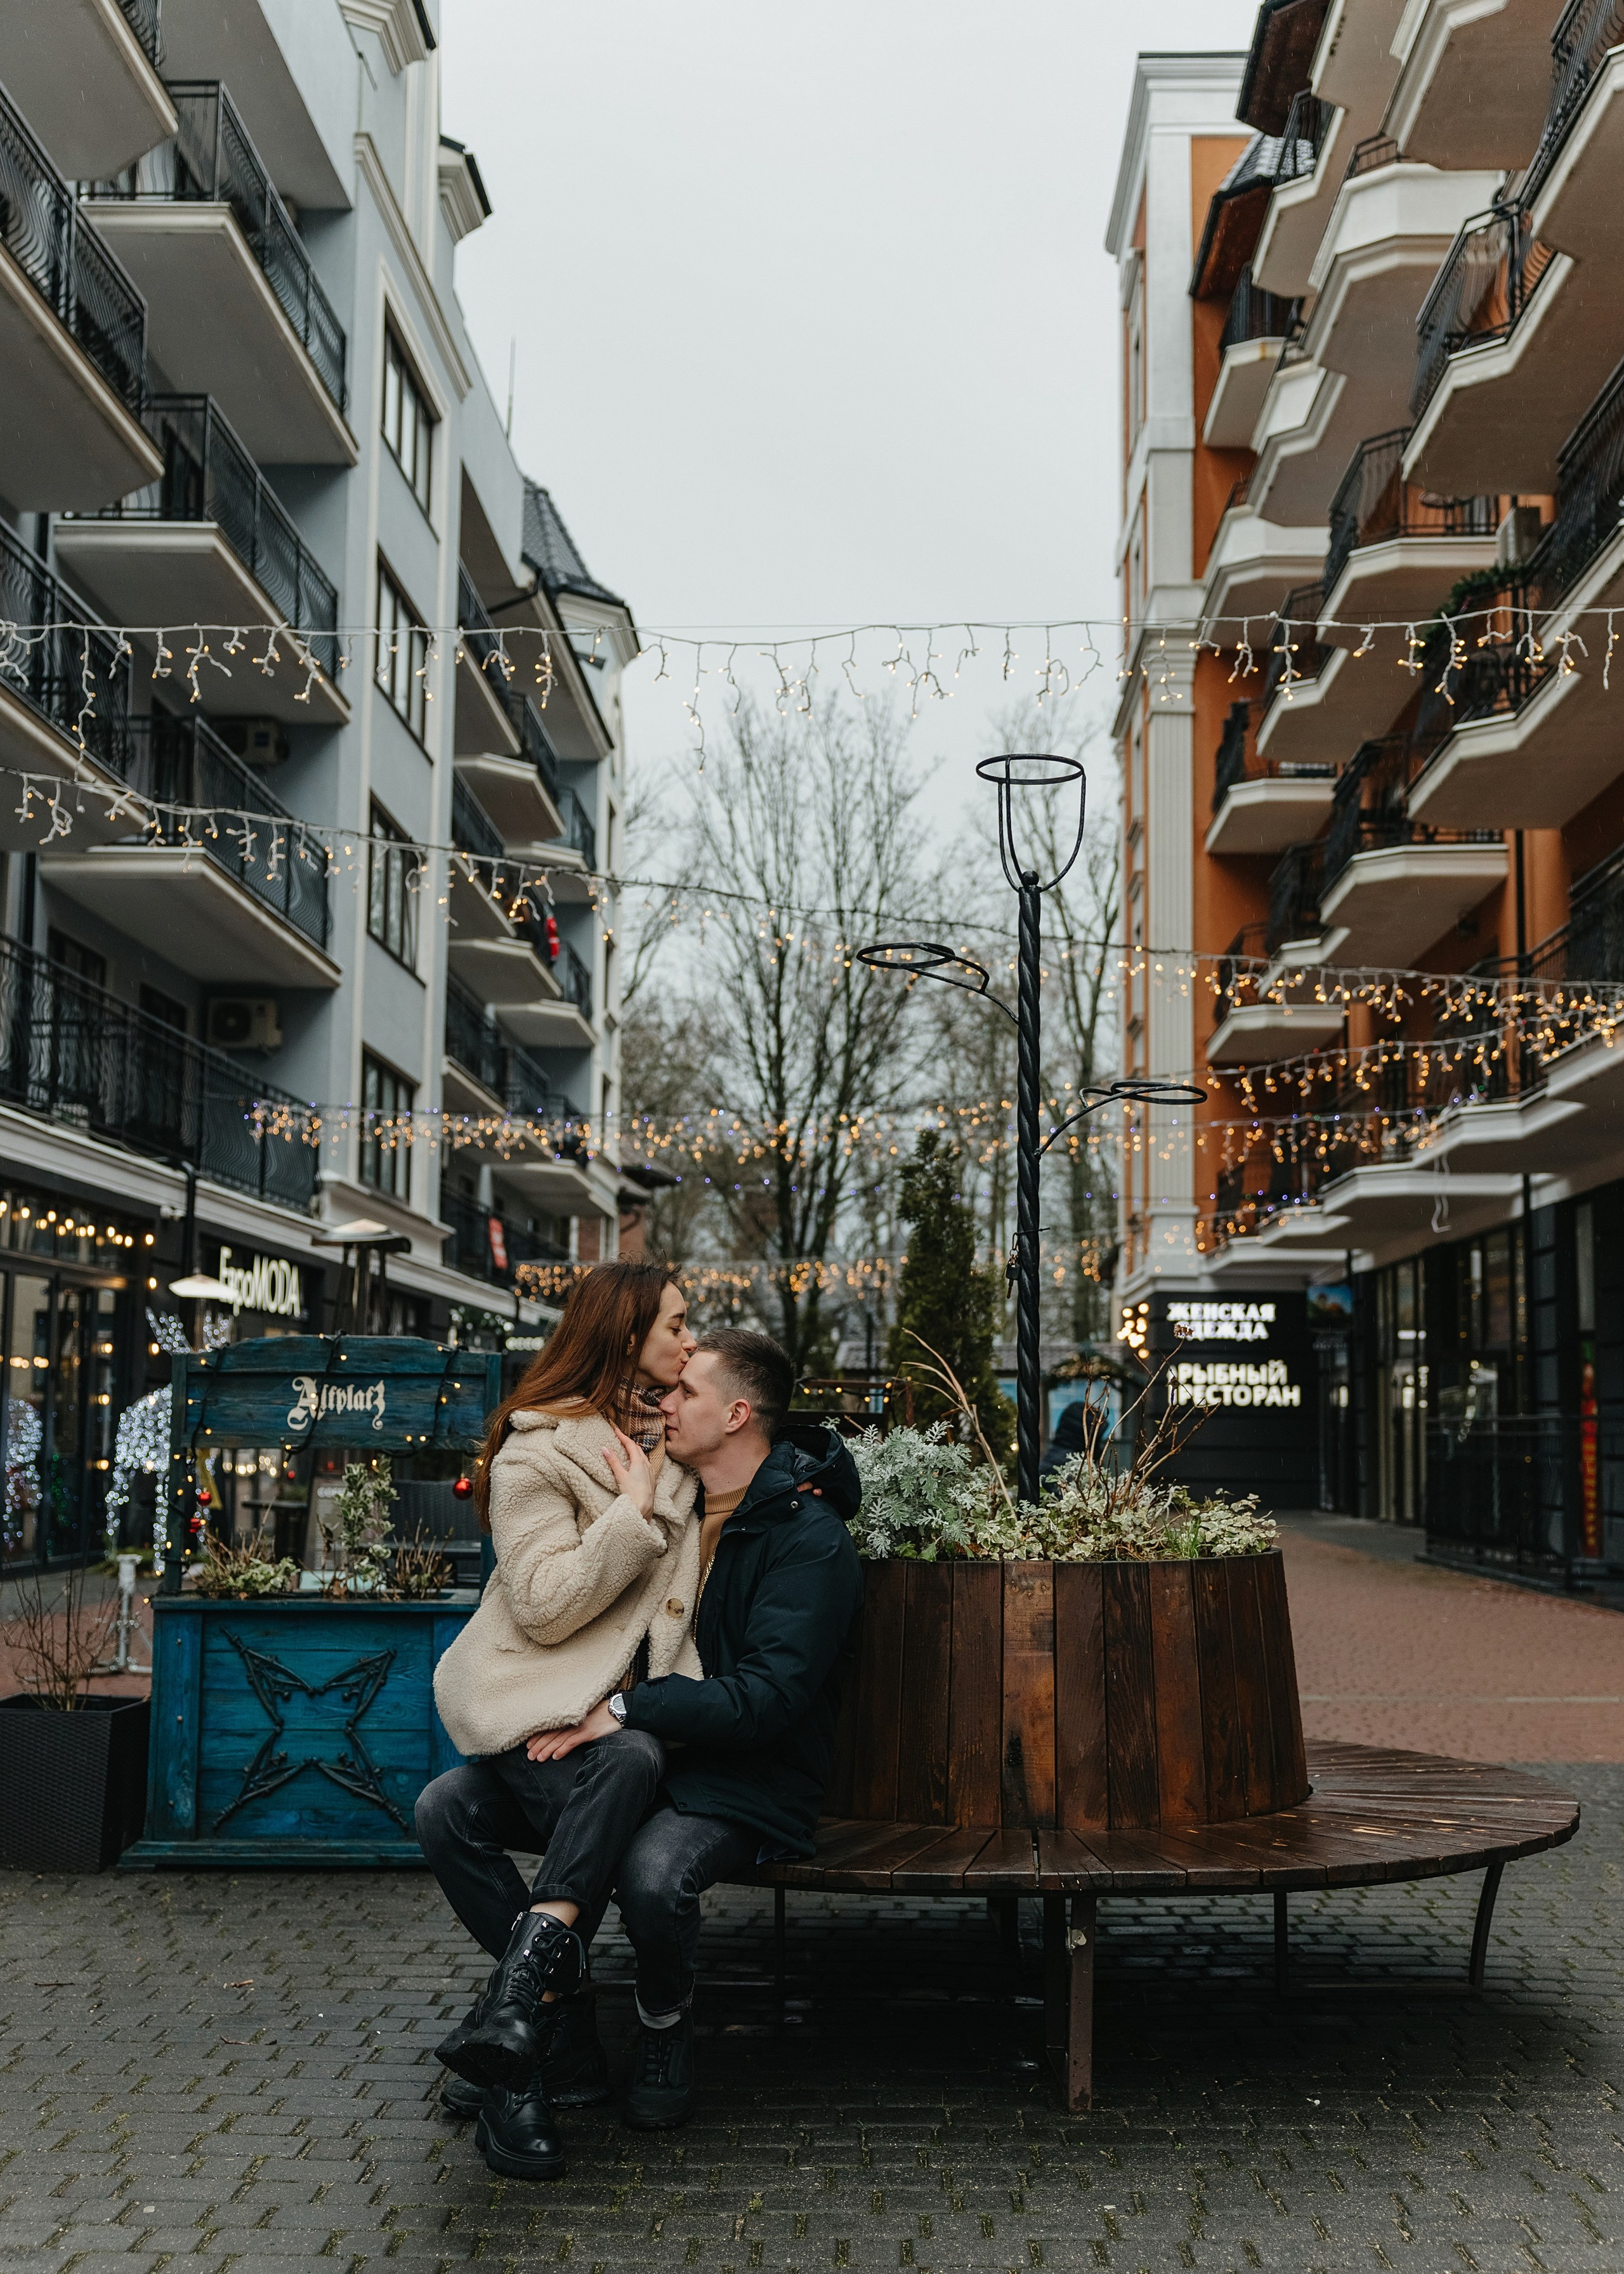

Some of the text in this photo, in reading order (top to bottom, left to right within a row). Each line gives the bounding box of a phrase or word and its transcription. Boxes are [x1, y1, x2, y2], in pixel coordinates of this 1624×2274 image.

[1167, 1303, 1276, 1322] ЖЕНСКАЯ
[1178, 1359, 1288, 1385] РЫБНЫЙ
[1178, 1384, 1301, 1407] РЕСТОРАН
